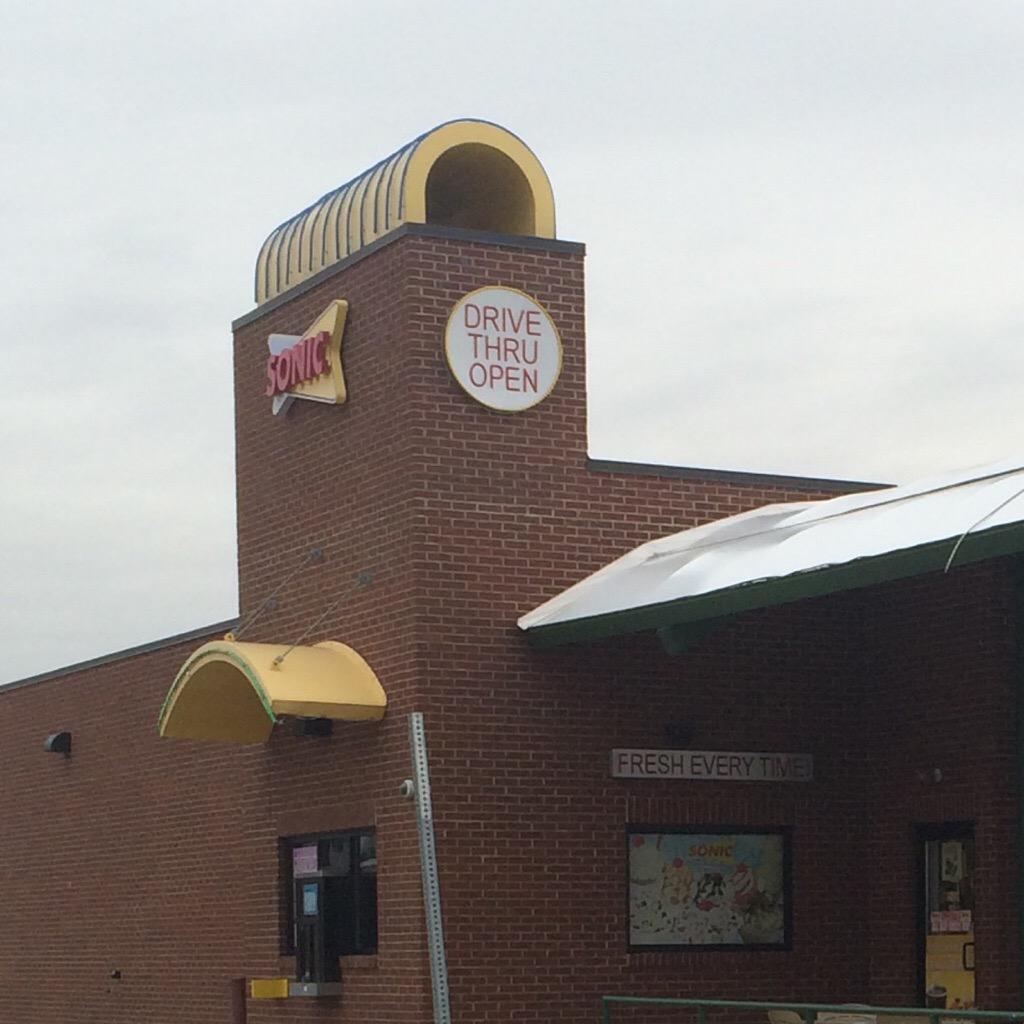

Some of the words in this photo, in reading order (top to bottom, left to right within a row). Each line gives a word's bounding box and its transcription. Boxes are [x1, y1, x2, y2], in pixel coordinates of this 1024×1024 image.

[464, 303, 542, 337] DRIVE
[263, 331, 331, 397] SONIC
[467, 333, 539, 365] THRU
[468, 363, 539, 393] OPEN
[617, 753, 684, 775] FRESH
[690, 755, 756, 777] EVERY
